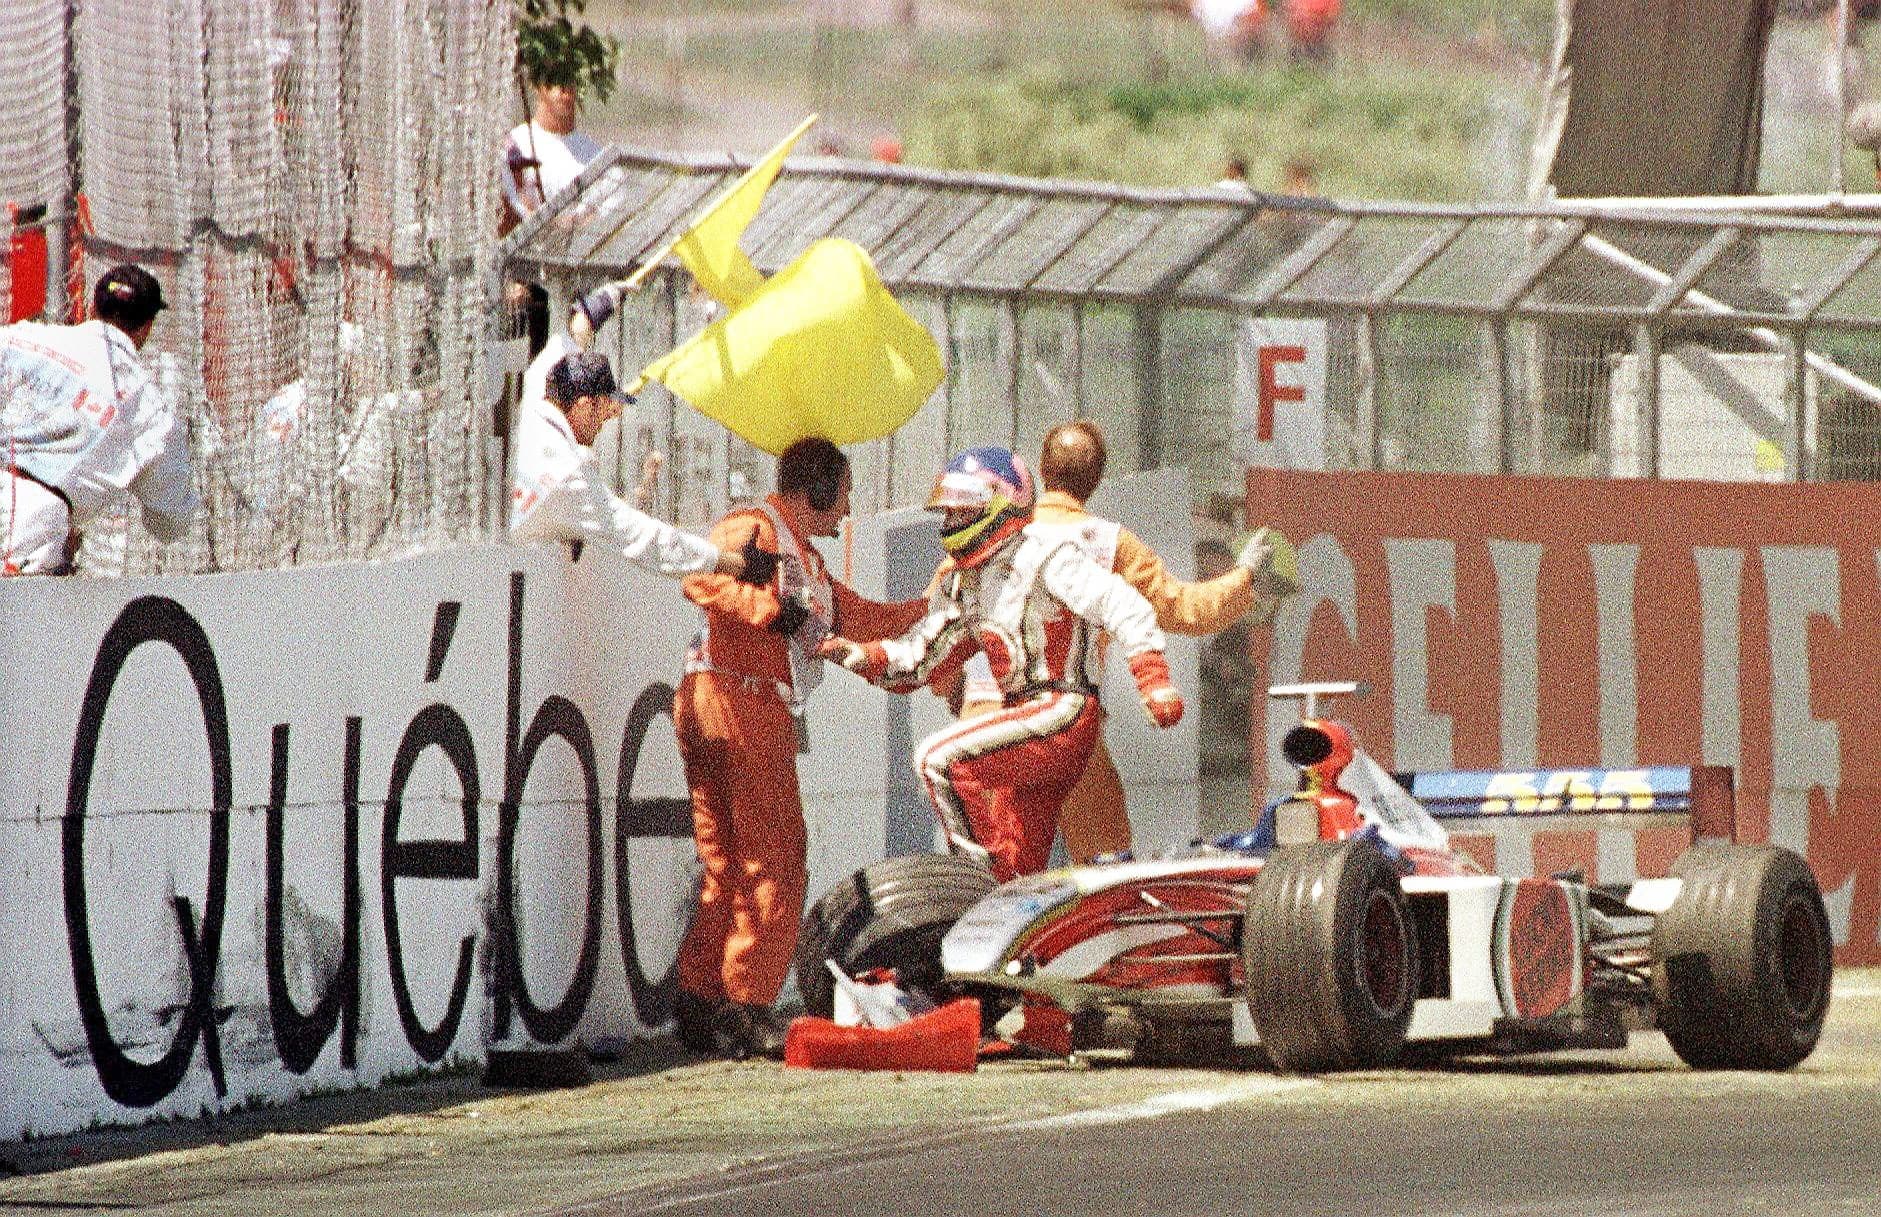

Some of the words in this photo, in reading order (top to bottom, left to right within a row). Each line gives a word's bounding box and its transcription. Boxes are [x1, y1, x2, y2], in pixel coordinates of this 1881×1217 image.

[1256, 345, 1306, 442] F
[62, 571, 696, 1107] Québe
[1267, 532, 1881, 945] CELLIE
